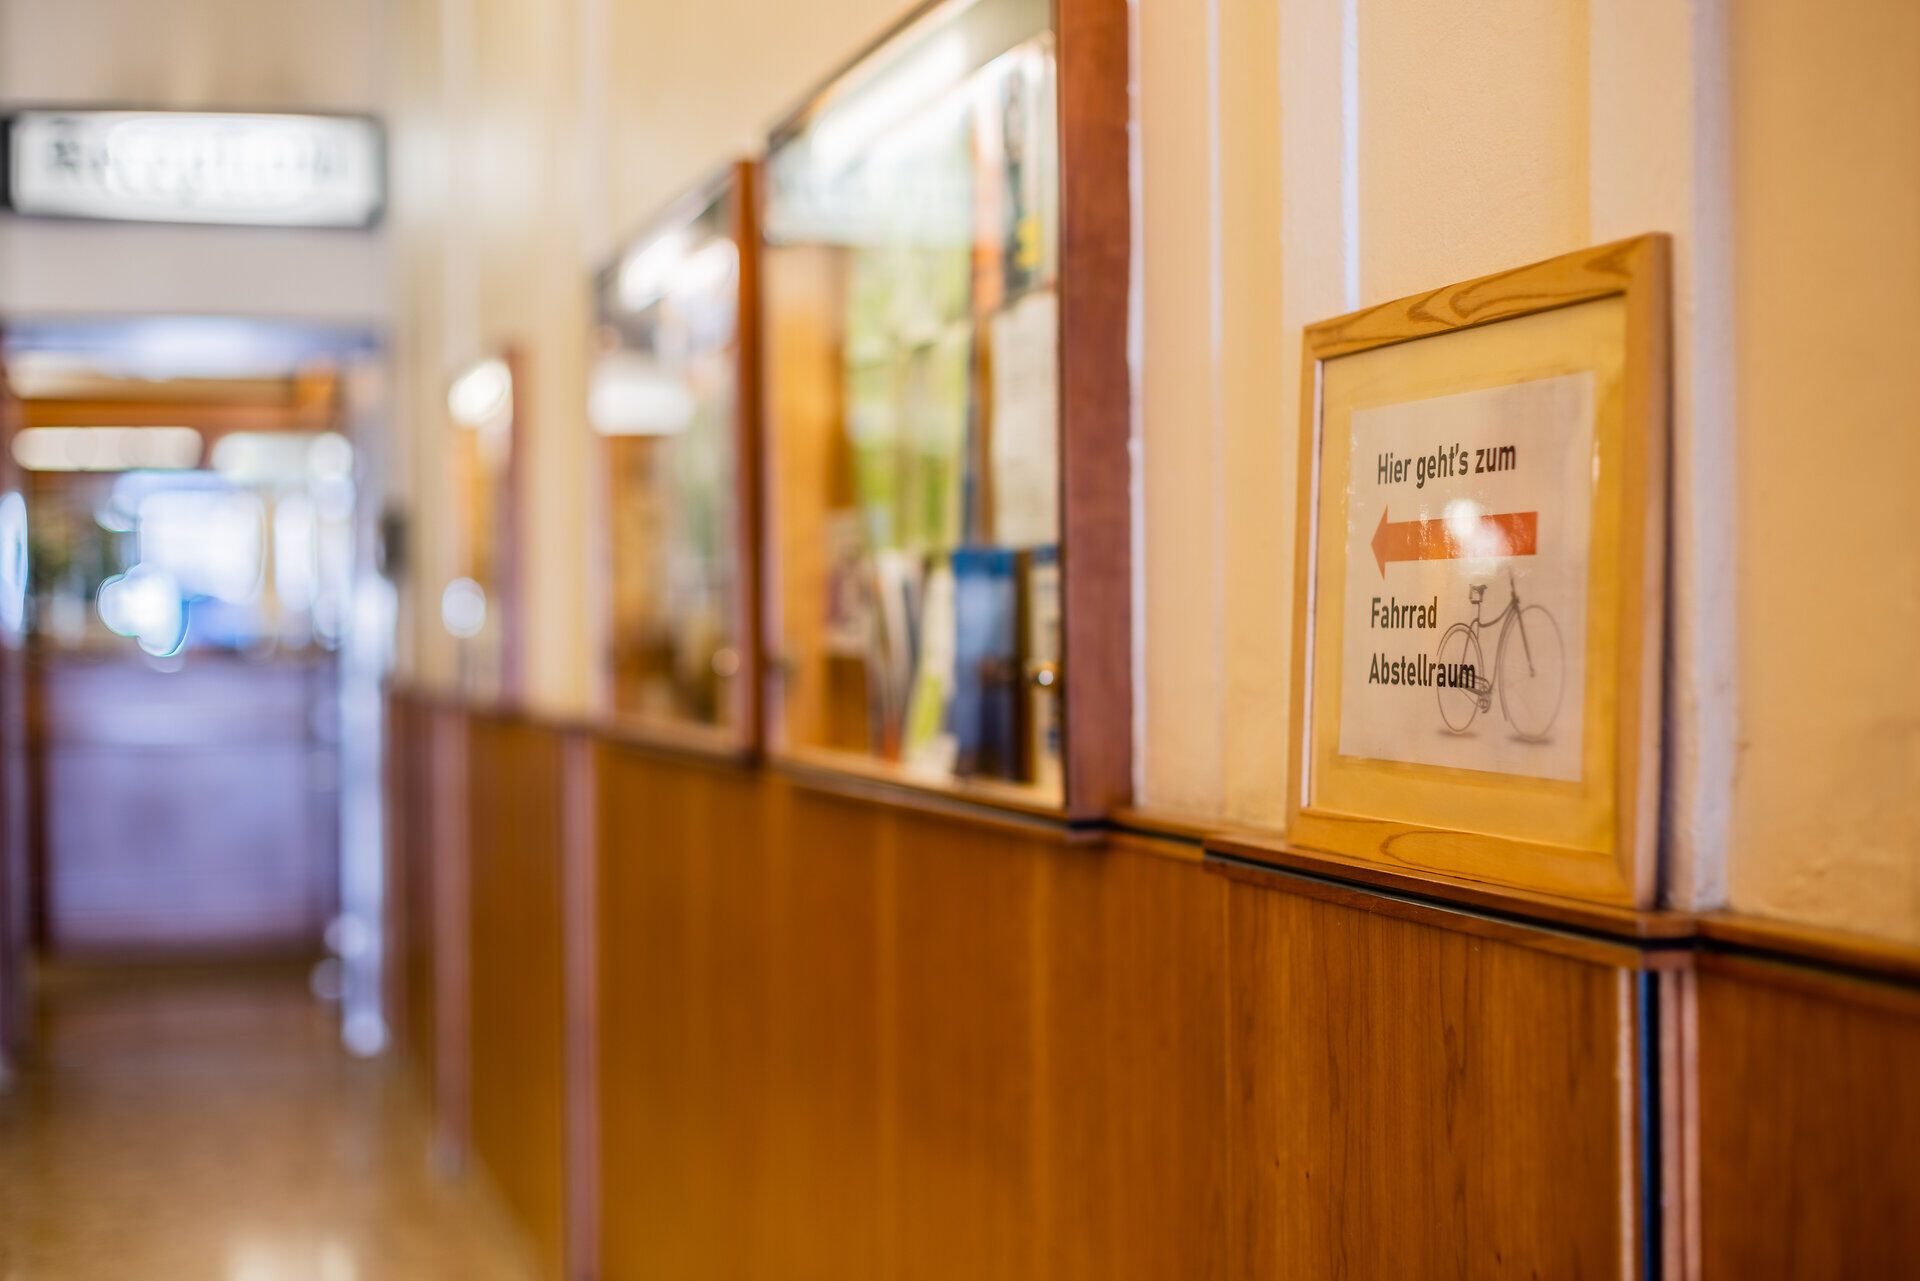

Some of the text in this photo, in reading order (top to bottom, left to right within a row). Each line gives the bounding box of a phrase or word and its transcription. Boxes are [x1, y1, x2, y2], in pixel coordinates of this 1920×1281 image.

[1377, 443, 1516, 488] Hier geht's zum
[1371, 596, 1438, 629] Fahrrad
[1368, 653, 1476, 688] Abstellraum
